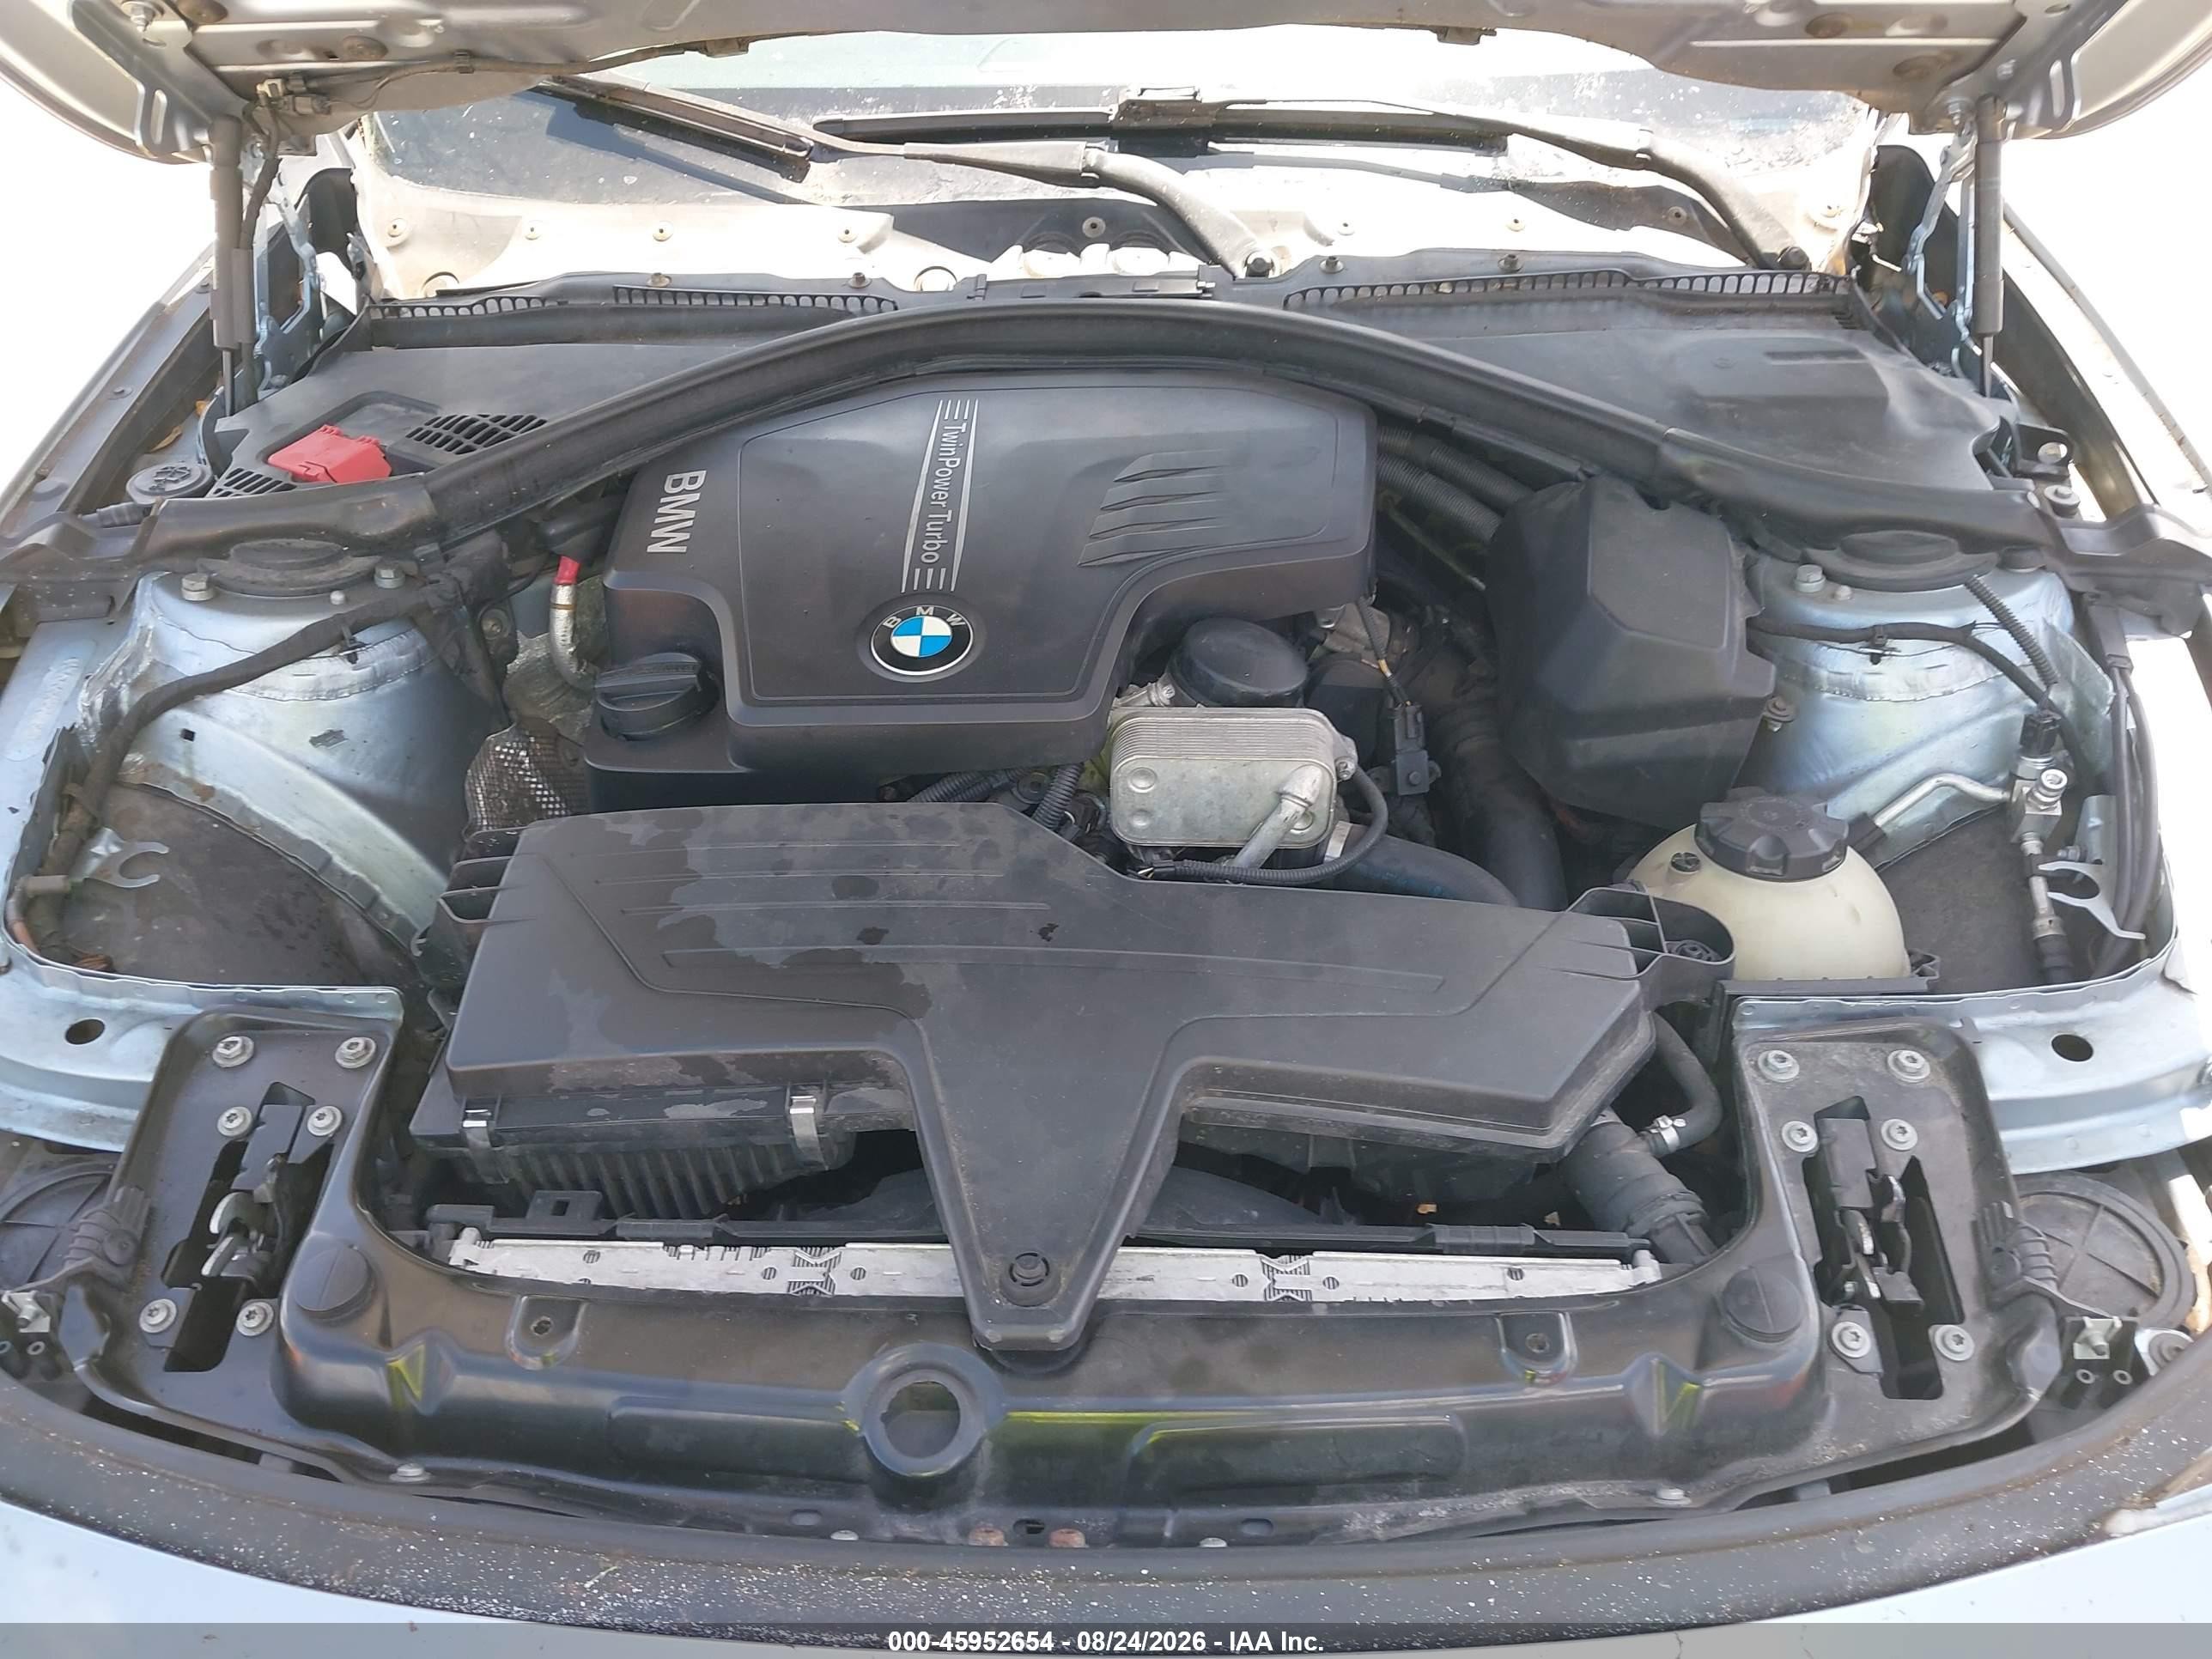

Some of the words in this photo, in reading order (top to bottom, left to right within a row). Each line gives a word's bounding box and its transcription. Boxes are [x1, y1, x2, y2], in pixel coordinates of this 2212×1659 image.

[930, 422, 967, 507] TwinPower
[647, 471, 707, 552] BMW
[921, 509, 952, 565] Turbo
[883, 606, 965, 629] BMW
